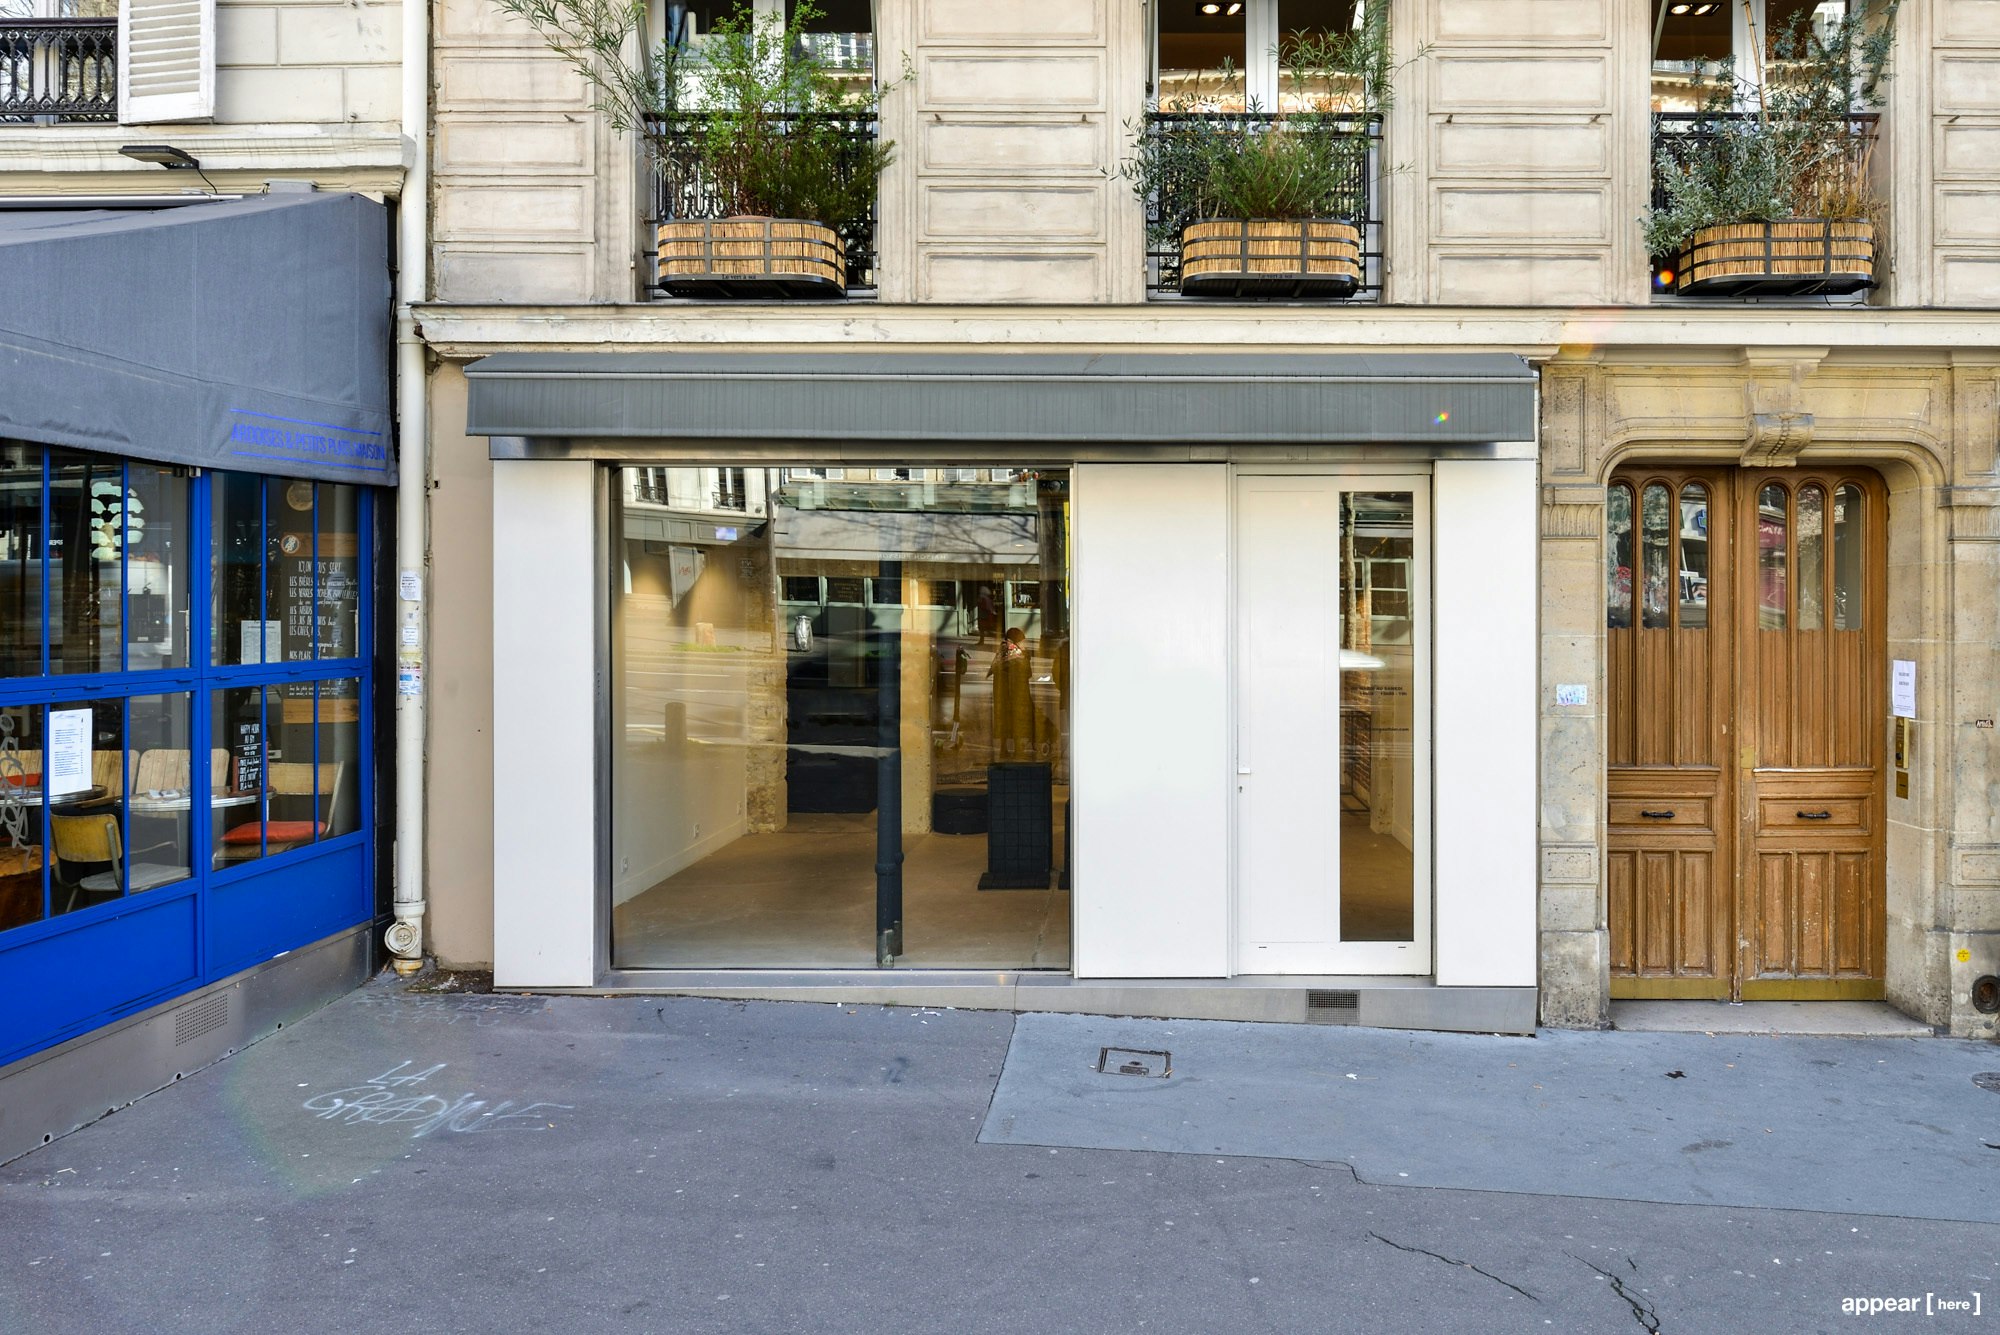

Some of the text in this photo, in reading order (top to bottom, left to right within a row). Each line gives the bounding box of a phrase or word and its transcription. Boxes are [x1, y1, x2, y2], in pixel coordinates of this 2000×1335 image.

[296, 431, 326, 454] PETITS
[354, 441, 385, 461] MAISON
[289, 575, 297, 587] LES
[289, 587, 297, 598] LES
